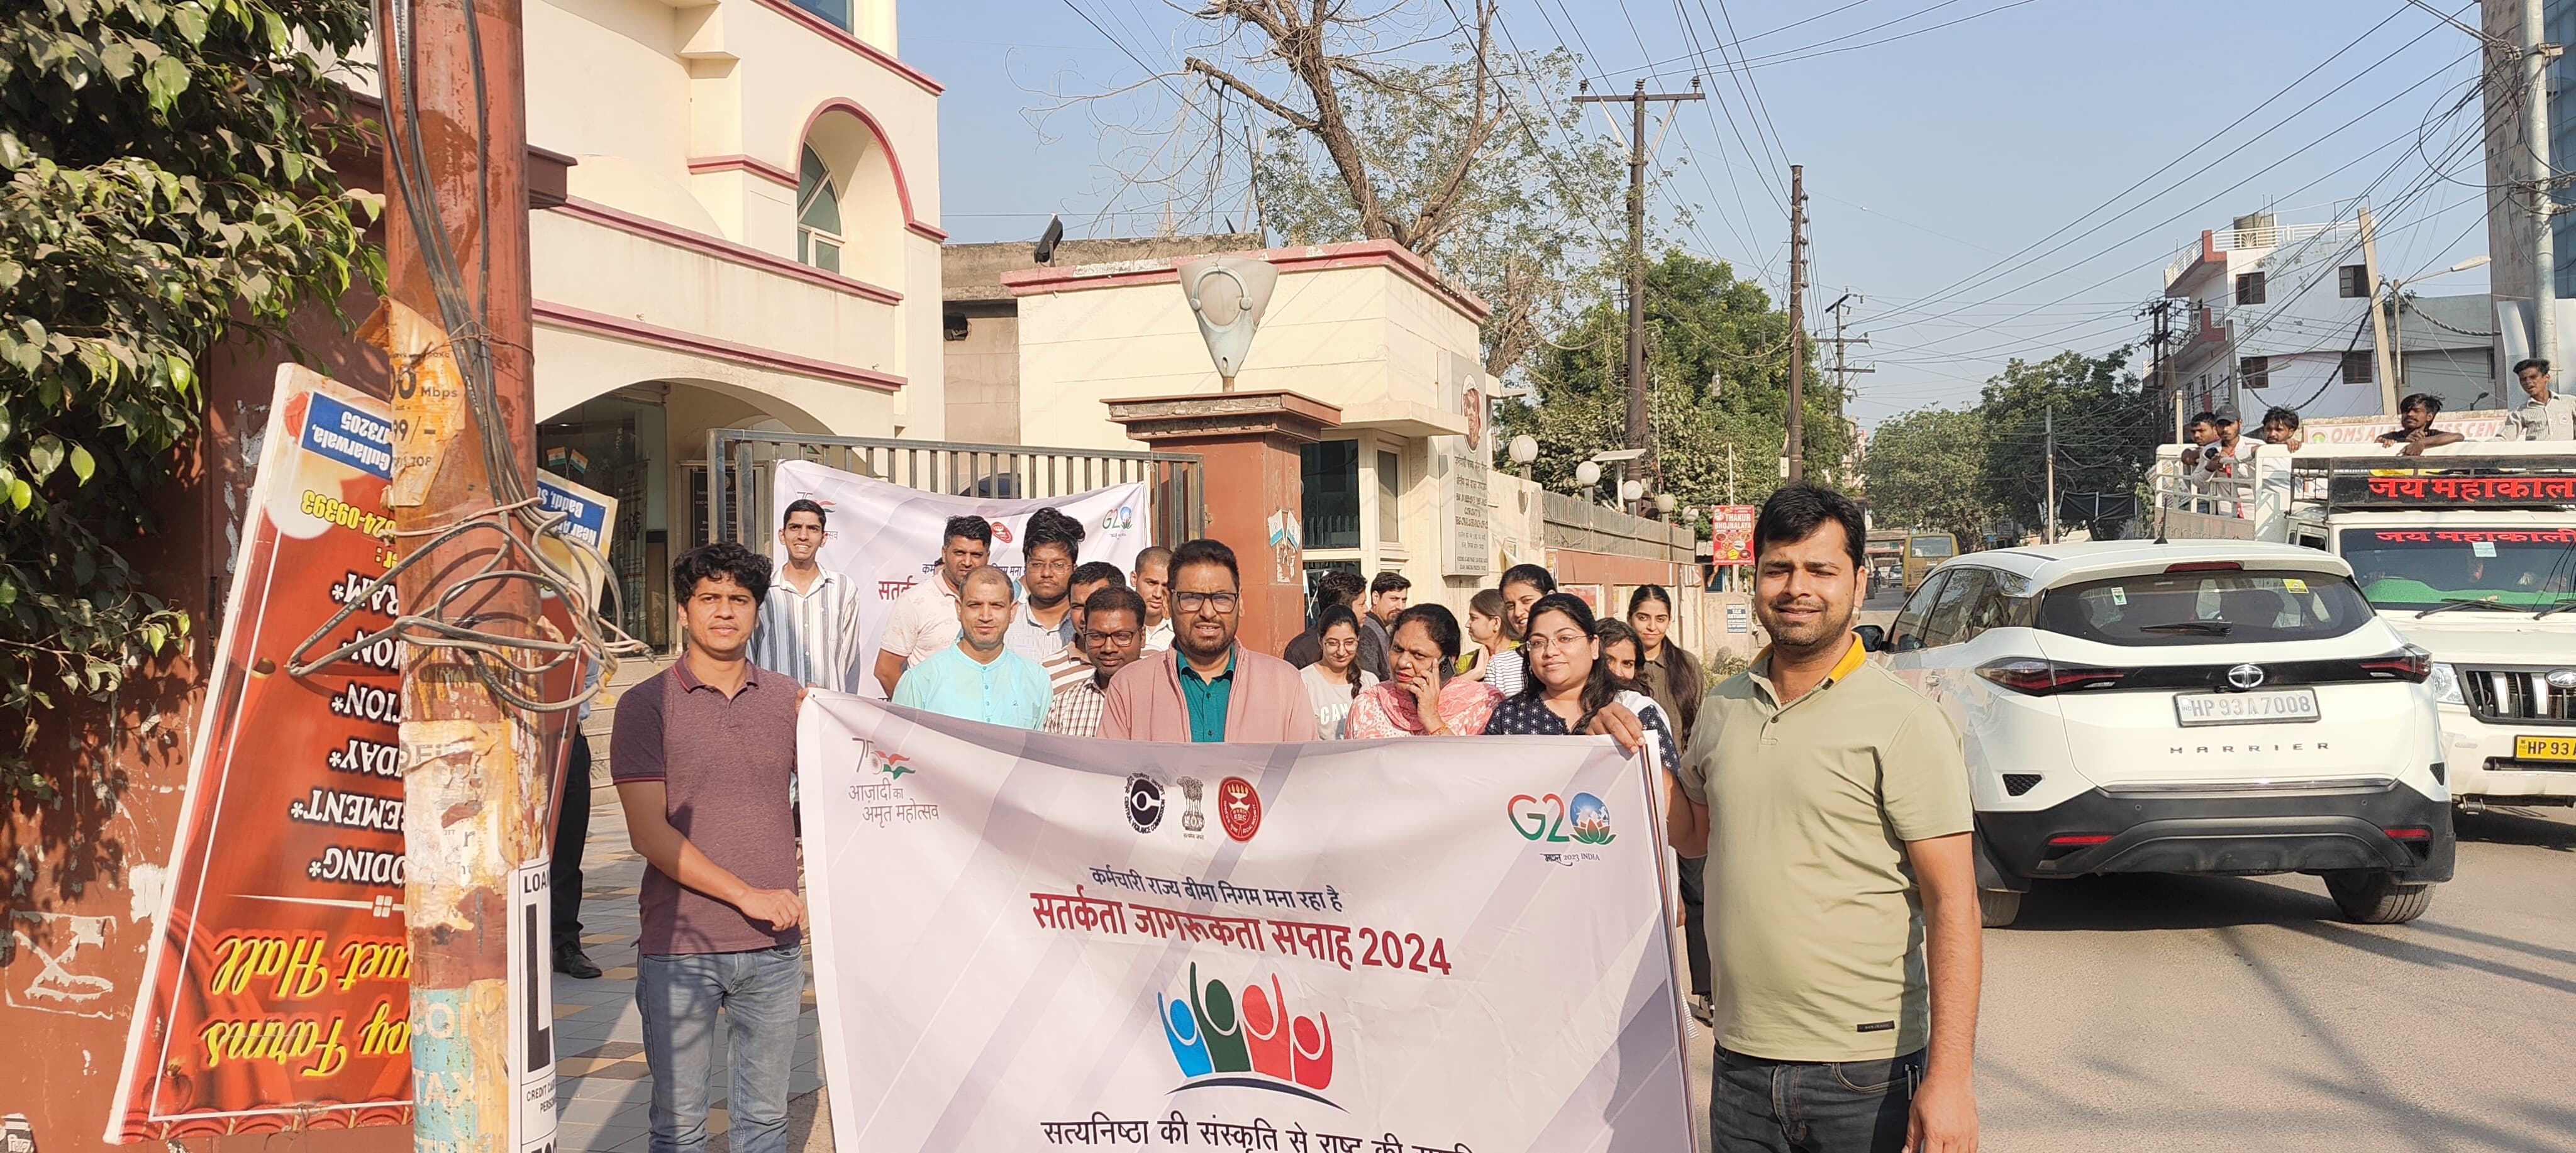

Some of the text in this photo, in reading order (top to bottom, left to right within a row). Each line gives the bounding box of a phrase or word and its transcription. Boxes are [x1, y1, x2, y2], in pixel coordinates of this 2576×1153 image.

[421, 387, 458, 399] Mbps
[312, 424, 391, 471] Gullarwala,
[2368, 478, 2428, 498] जय
[550, 491, 584, 518] Baddi,
[1725, 514, 1751, 522] THAKUR
[570, 523, 597, 545] Near
[2375, 531, 2431, 542] जय
[2191, 699, 2215, 717] HP
[2219, 698, 2244, 715] 93
[2170, 742, 2329, 754] HARRIER
[2528, 741, 2547, 754] HP
[2550, 742, 2569, 755] 93
[892, 788, 904, 799] का
[291, 790, 404, 832] EMENT
[863, 797, 940, 829] अमृत महोत्सव
[1507, 793, 1617, 845] G20
[1089, 864, 1343, 912] कर्मचारी राज्य बीमा निगम मना रहा है
[1030, 884, 1453, 976] सतर्कता जागरूकता सप्ताह 2024
[212, 938, 328, 998] Hall
[199, 1018, 347, 1077] Farms
[526, 1086, 547, 1102] CREDIT
[1040, 1111, 1148, 1145] सत्यनिष्ठा
[1157, 1110, 1188, 1144] की
[1196, 1113, 1277, 1153] संस्कृति
[1285, 1122, 1308, 1153] से
